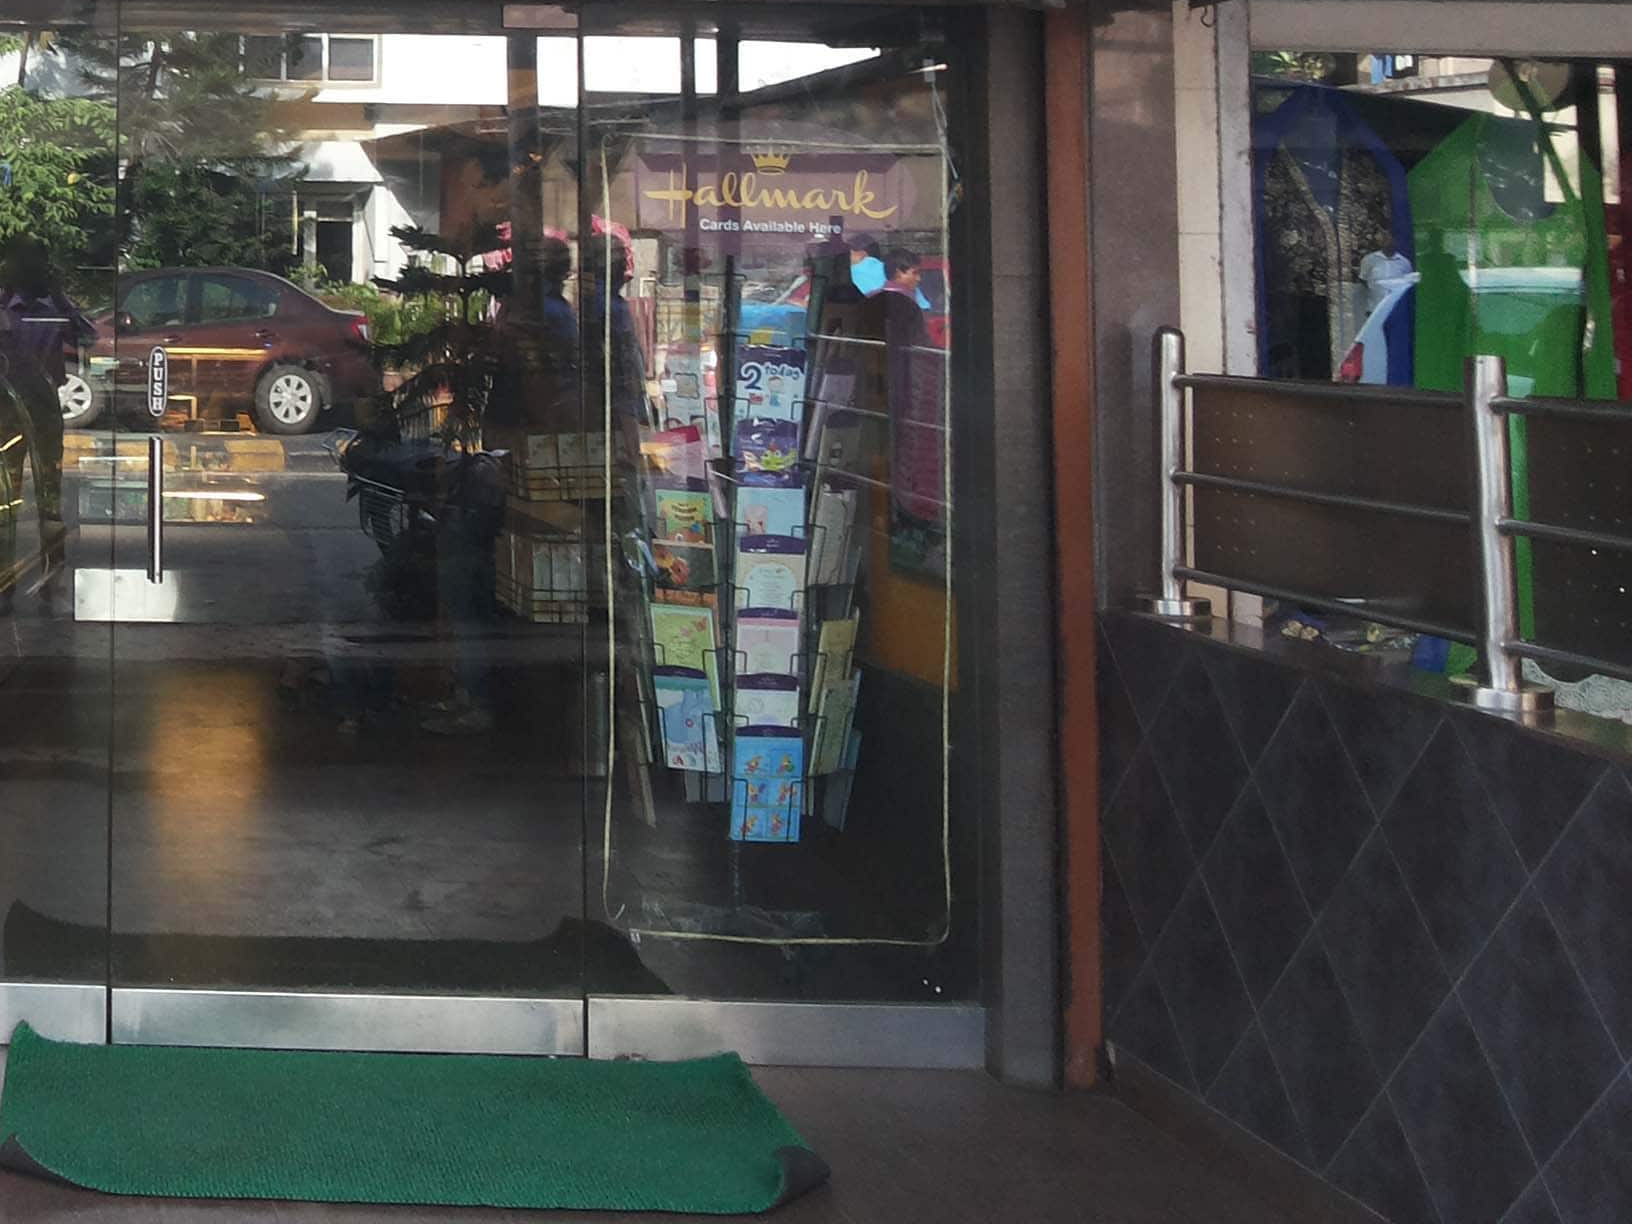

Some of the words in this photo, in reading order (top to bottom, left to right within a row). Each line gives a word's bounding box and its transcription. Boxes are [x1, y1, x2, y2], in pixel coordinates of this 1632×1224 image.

[643, 162, 899, 230] Hallmark
[699, 218, 740, 232] Cards
[742, 219, 806, 234] Available
[809, 222, 842, 235] Here
[151, 352, 164, 411] PUSH
[740, 362, 762, 391] 2
